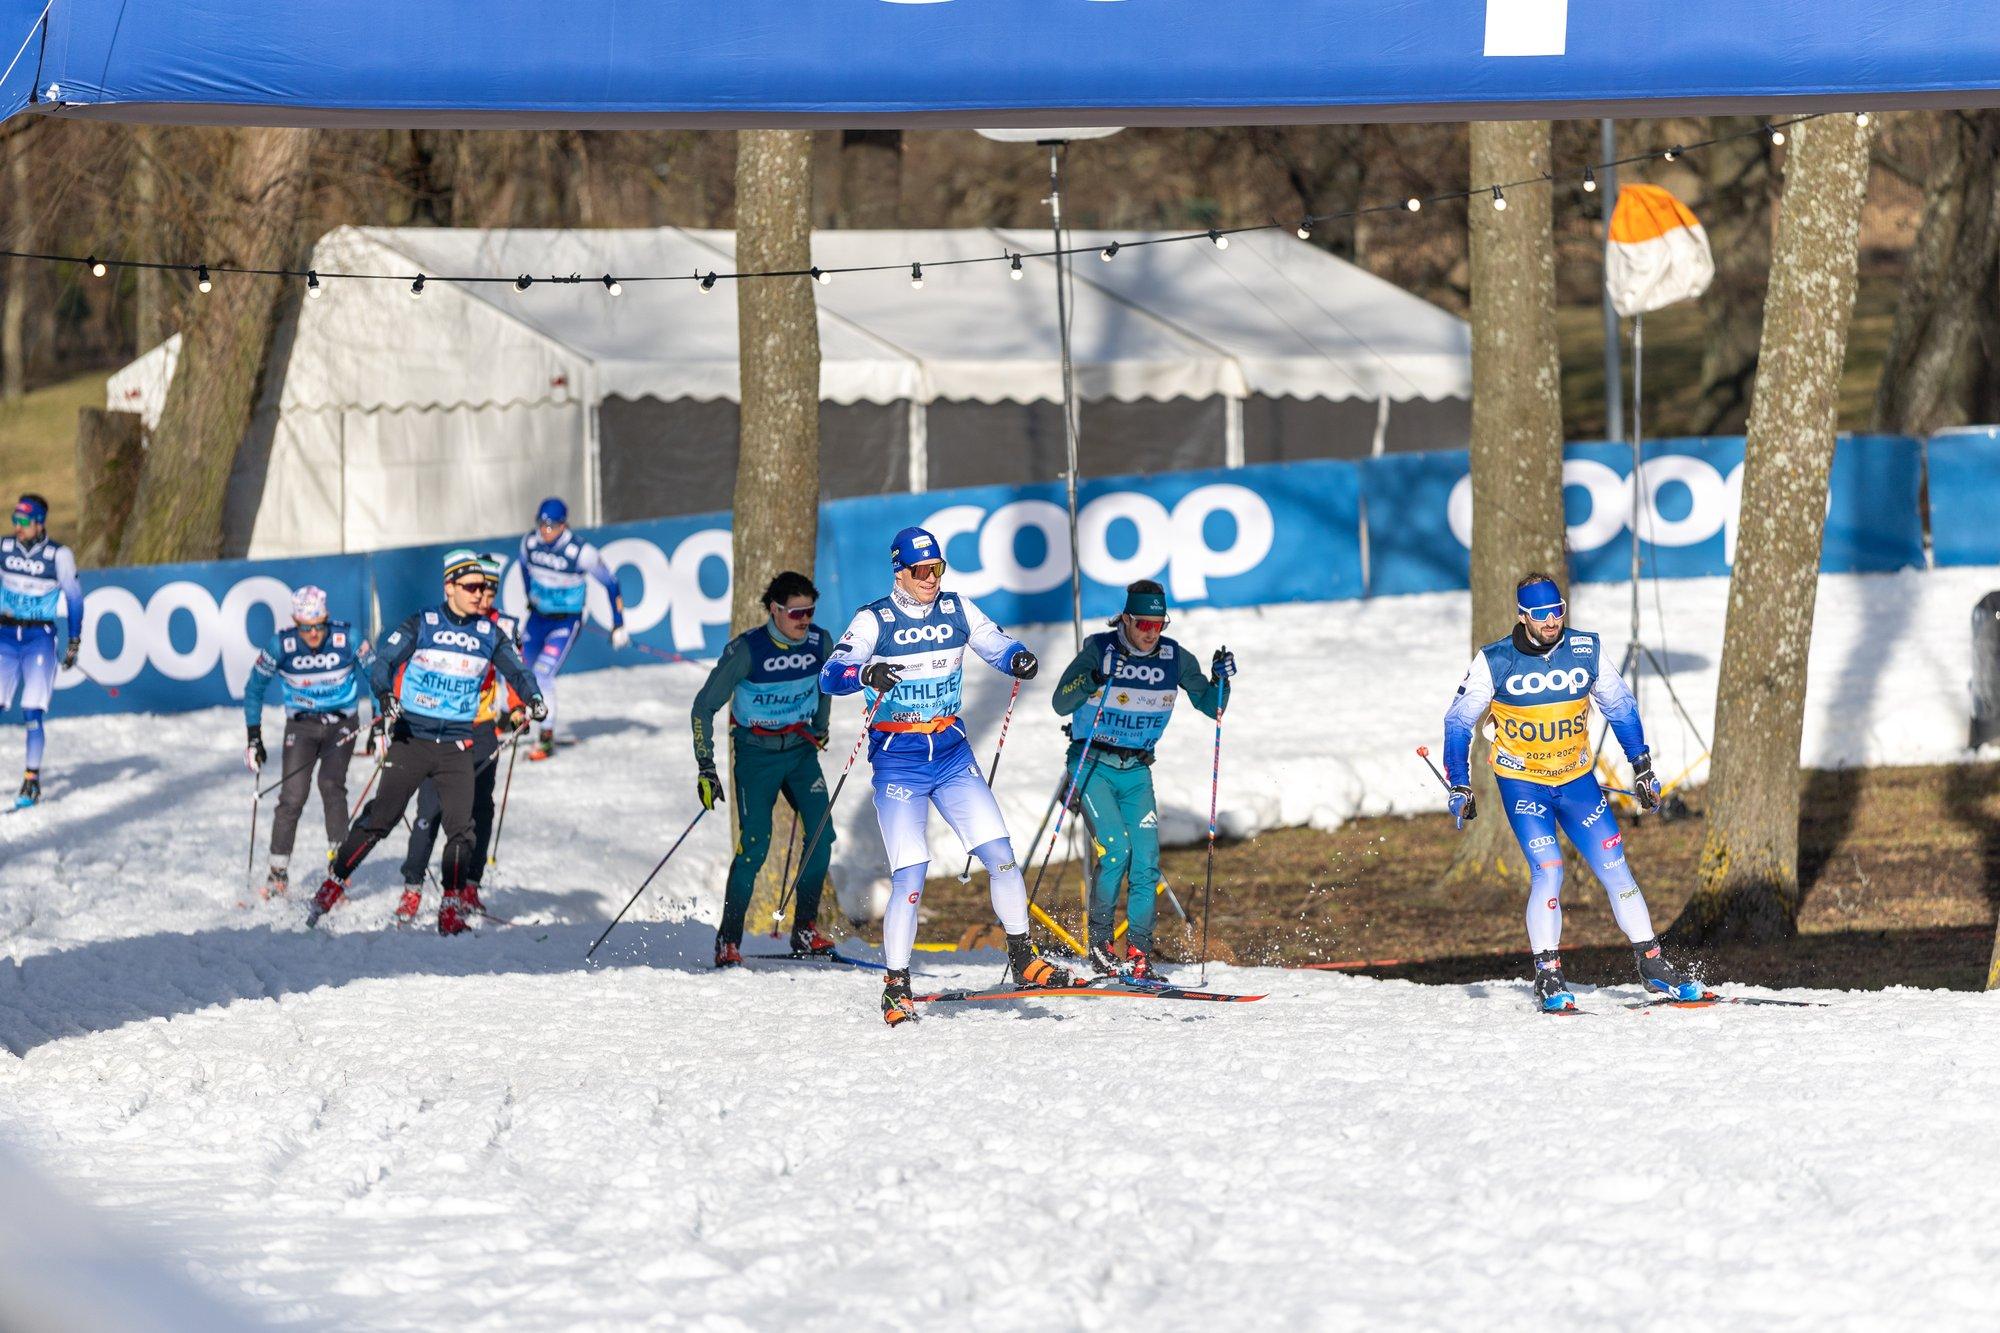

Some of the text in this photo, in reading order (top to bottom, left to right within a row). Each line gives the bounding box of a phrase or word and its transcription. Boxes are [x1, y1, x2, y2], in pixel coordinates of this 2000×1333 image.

[916, 484, 1274, 602] coop
[5, 555, 45, 576] coop
[433, 631, 480, 651] coop
[893, 623, 954, 645] coop
[292, 652, 341, 670] coop
[763, 653, 816, 671] coop
[421, 671, 477, 695] ATHLETE
[890, 675, 958, 702] ATHLETE
[1505, 667, 1590, 695] coop
[1098, 710, 1164, 730] ATHLETE
[886, 784, 913, 799] EA7
[1515, 799, 1547, 815] EA7
[1582, 792, 1608, 828] FALCO
